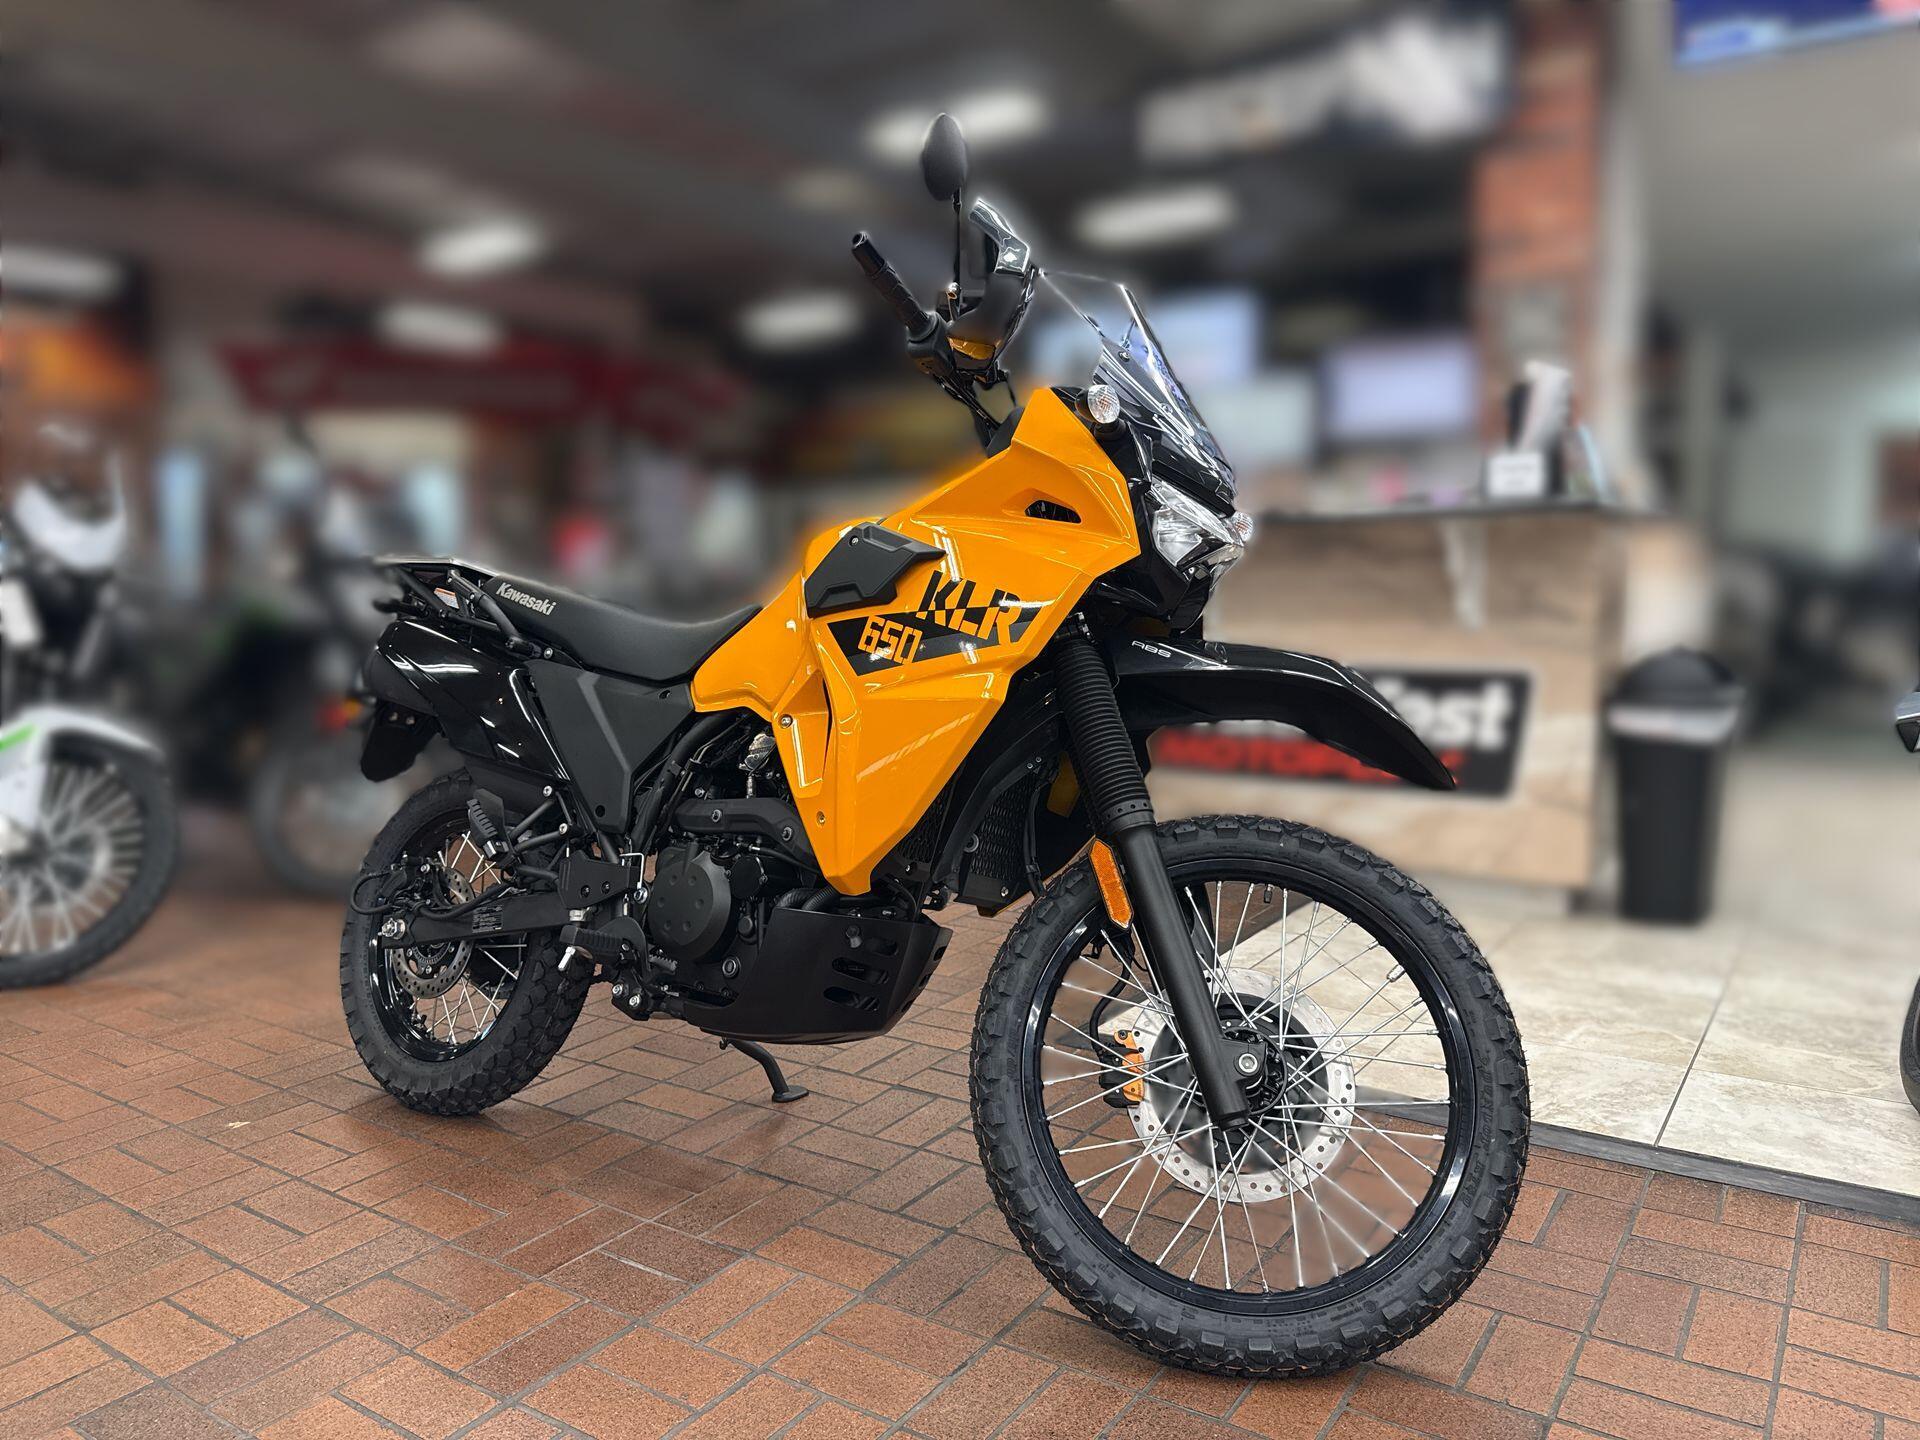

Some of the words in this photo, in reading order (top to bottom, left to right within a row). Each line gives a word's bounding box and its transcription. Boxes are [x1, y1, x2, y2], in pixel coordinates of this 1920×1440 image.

[496, 582, 556, 615] Kawasaki
[915, 570, 1022, 644] KLR
[858, 615, 923, 664] 650
[1131, 640, 1171, 658] ABS
